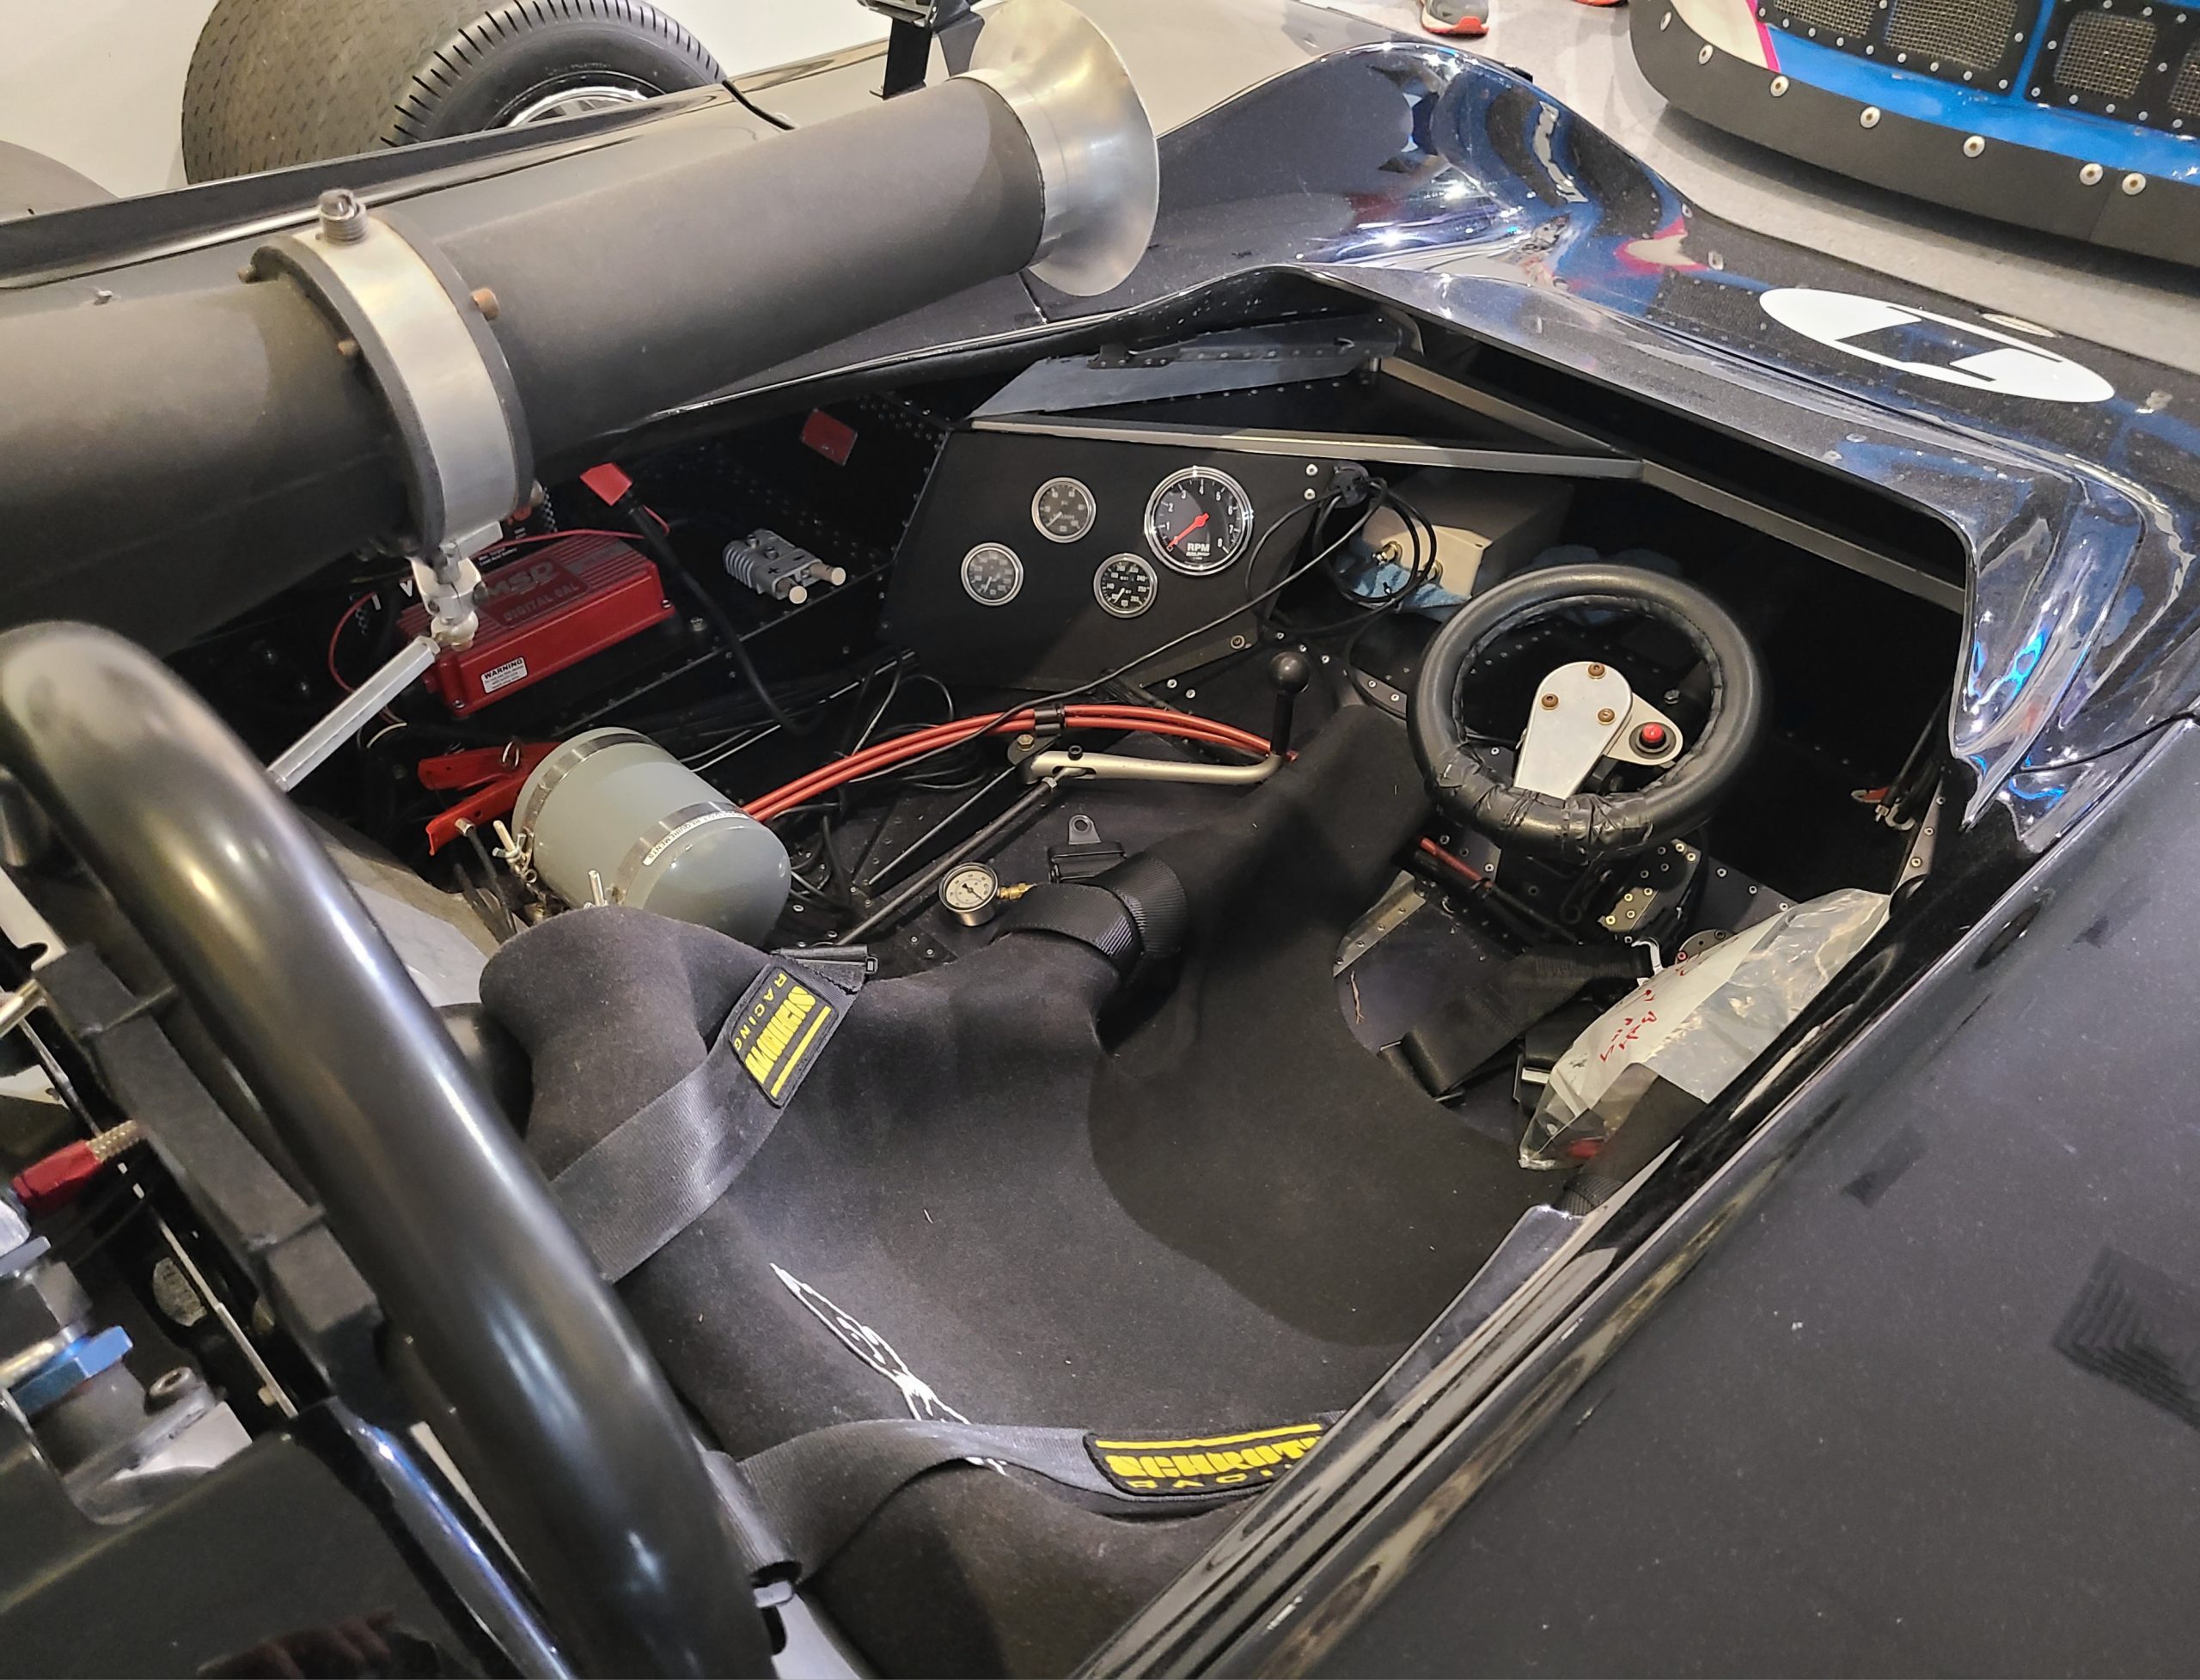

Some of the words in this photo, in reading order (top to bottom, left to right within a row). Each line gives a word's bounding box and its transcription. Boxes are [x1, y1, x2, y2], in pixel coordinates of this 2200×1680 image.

[1187, 542, 1210, 552] RPM
[504, 593, 553, 620] DIGITAL
[484, 659, 522, 679] WARNING
[648, 819, 701, 859] REQUIREMENTS
[733, 972, 789, 1051] RACING
